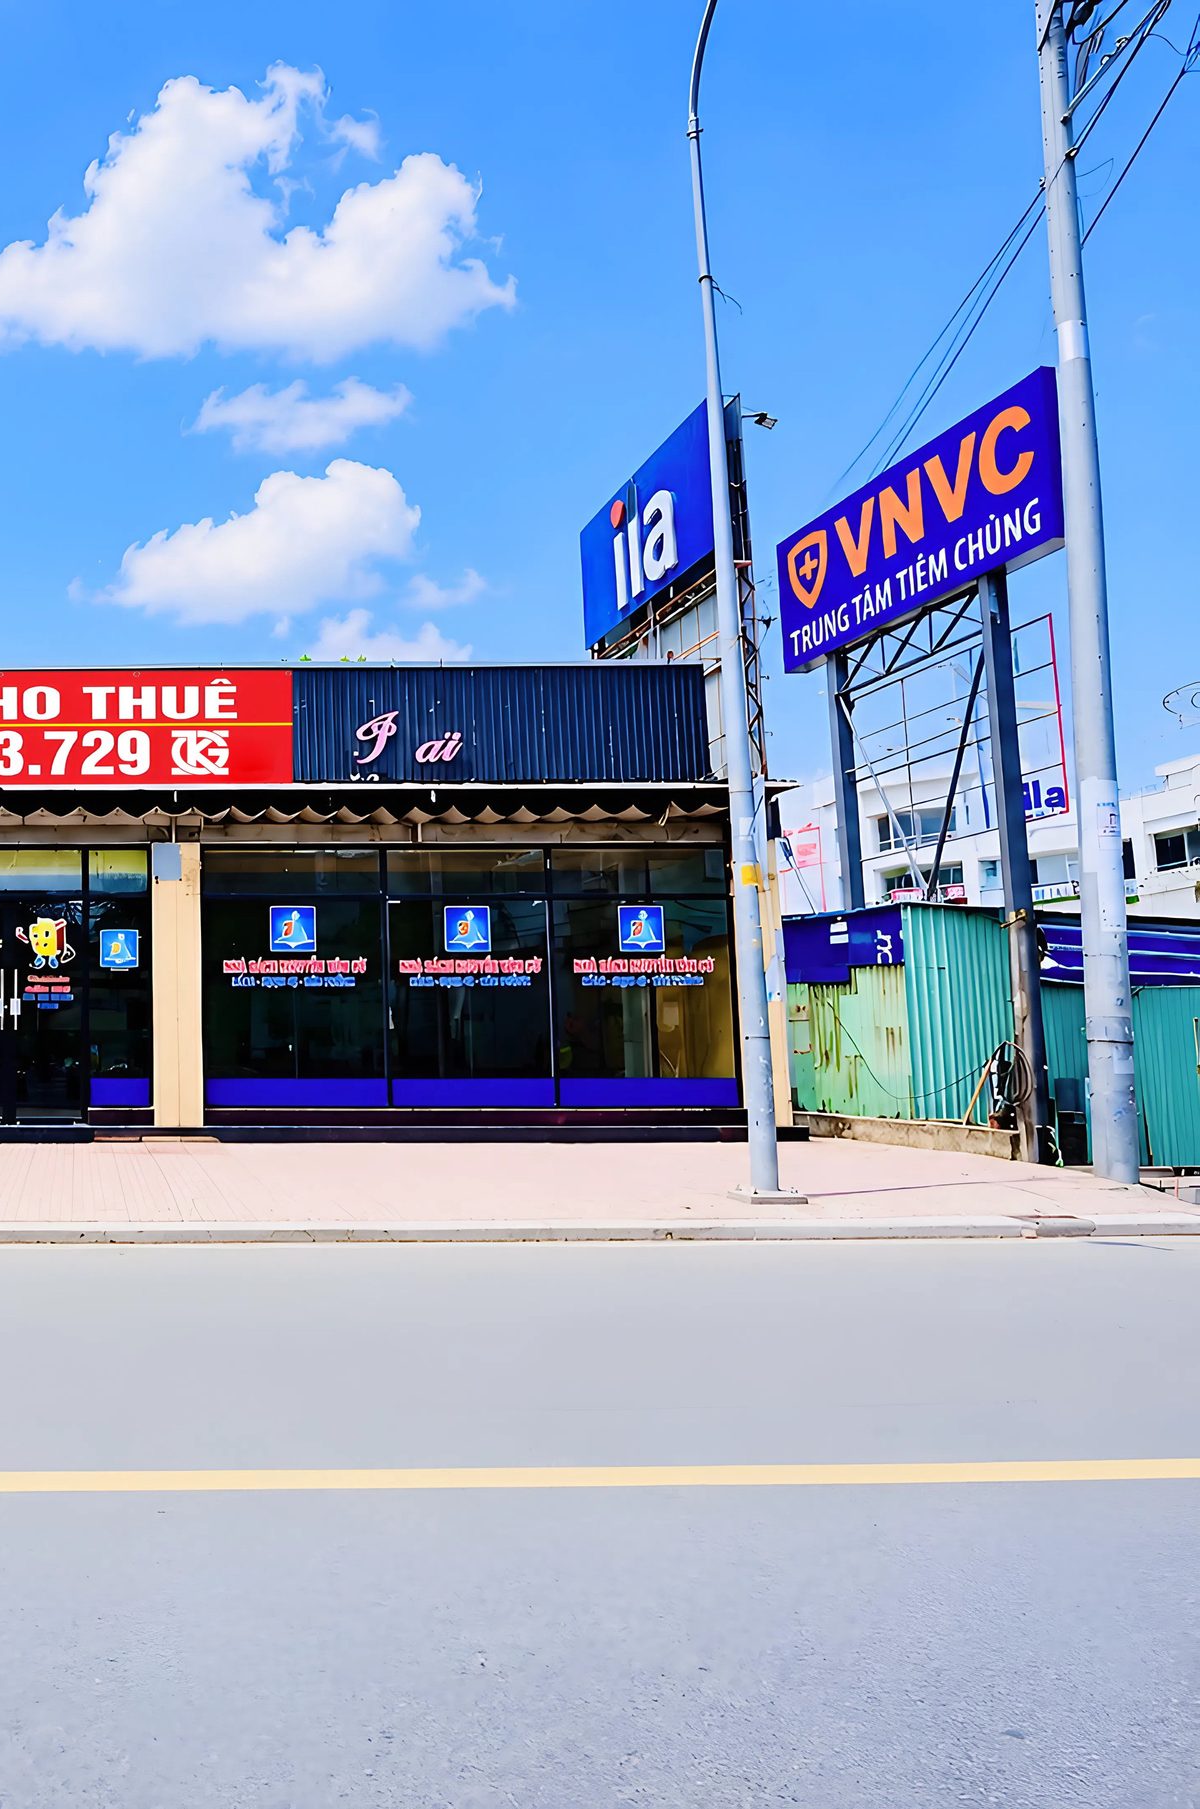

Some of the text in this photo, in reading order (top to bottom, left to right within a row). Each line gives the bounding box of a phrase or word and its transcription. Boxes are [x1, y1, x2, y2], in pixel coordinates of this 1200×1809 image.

[834, 405, 1035, 578] VNVC
[610, 484, 679, 611] ila
[790, 602, 850, 656] TRUNG
[82, 678, 238, 720] THUÊ
